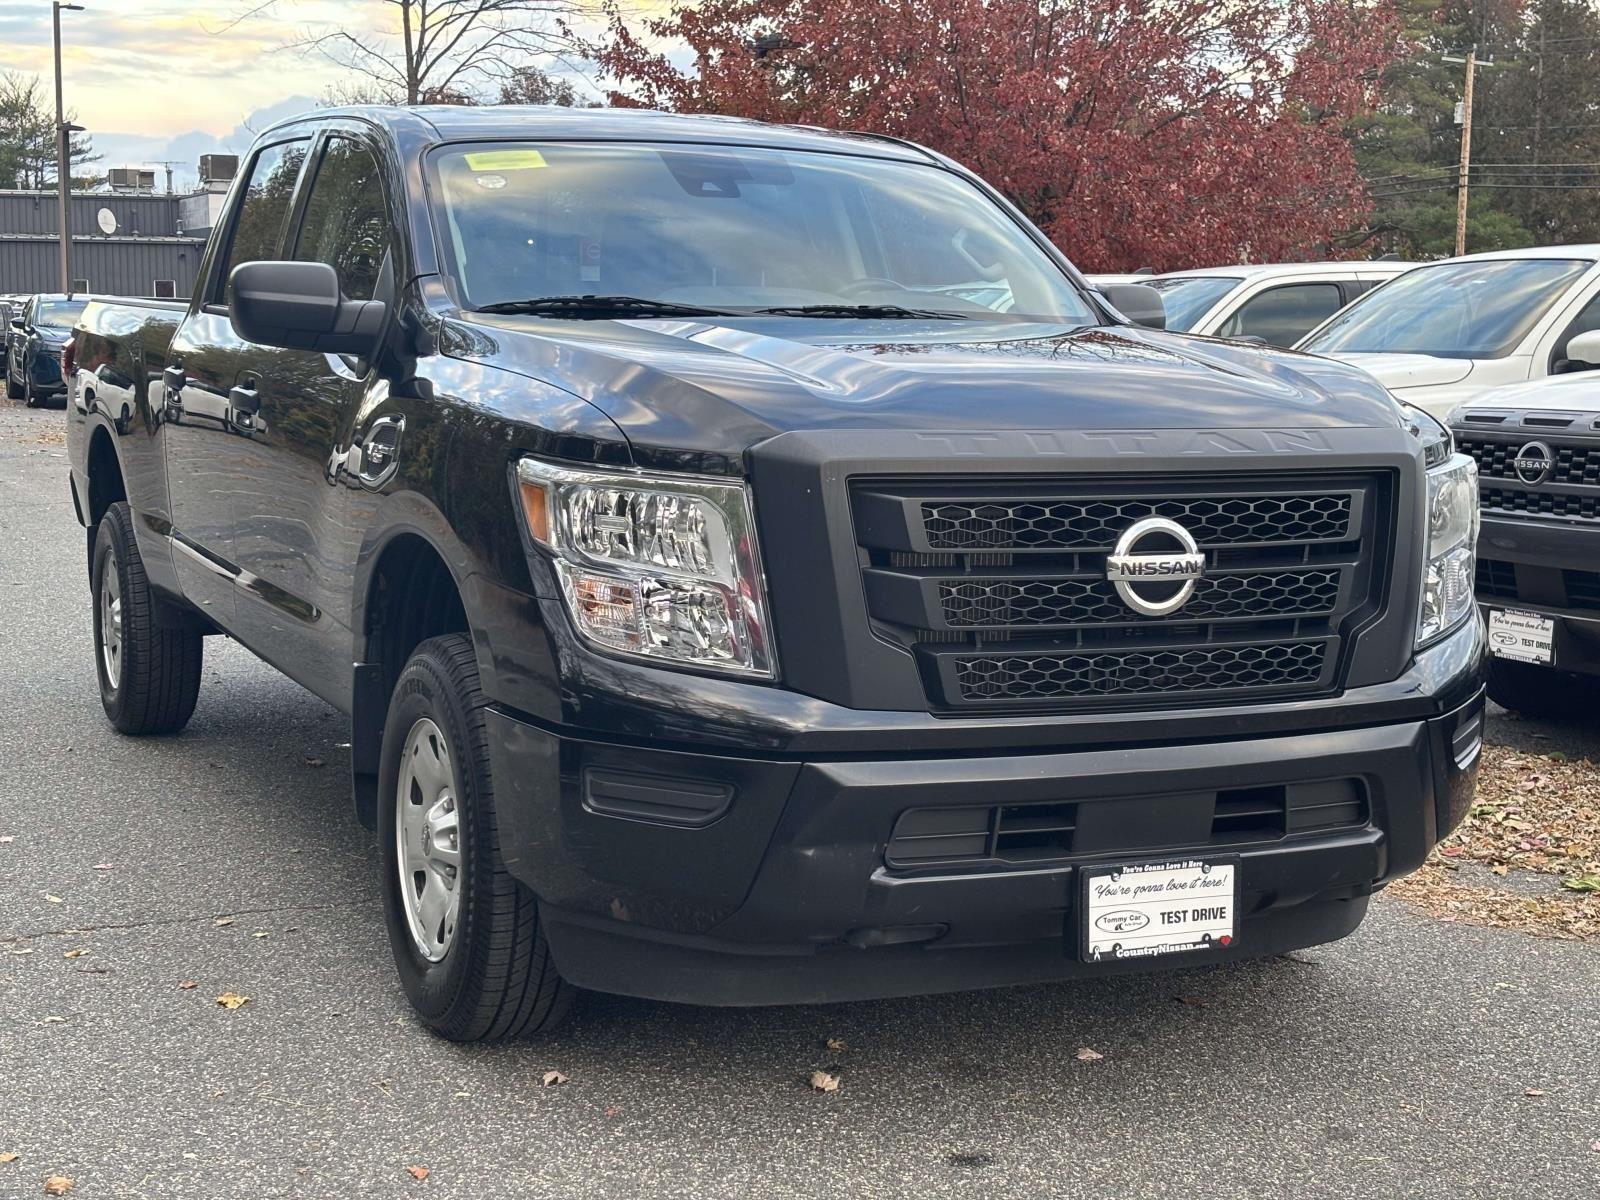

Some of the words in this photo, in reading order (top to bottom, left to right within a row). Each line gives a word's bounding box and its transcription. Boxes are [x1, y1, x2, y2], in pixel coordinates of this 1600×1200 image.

[914, 430, 1333, 455] TITAN
[1120, 560, 1198, 576] NISSAN
[1521, 638, 1534, 647] TEST
[1166, 862, 1181, 870] Love
[1094, 884, 1131, 899] You're
[1133, 884, 1164, 899] gonna
[1165, 878, 1188, 891] love
[1188, 876, 1201, 889] it
[1200, 875, 1227, 889] here!
[1160, 911, 1188, 925] TEST
[1192, 907, 1226, 922] DRIVE
